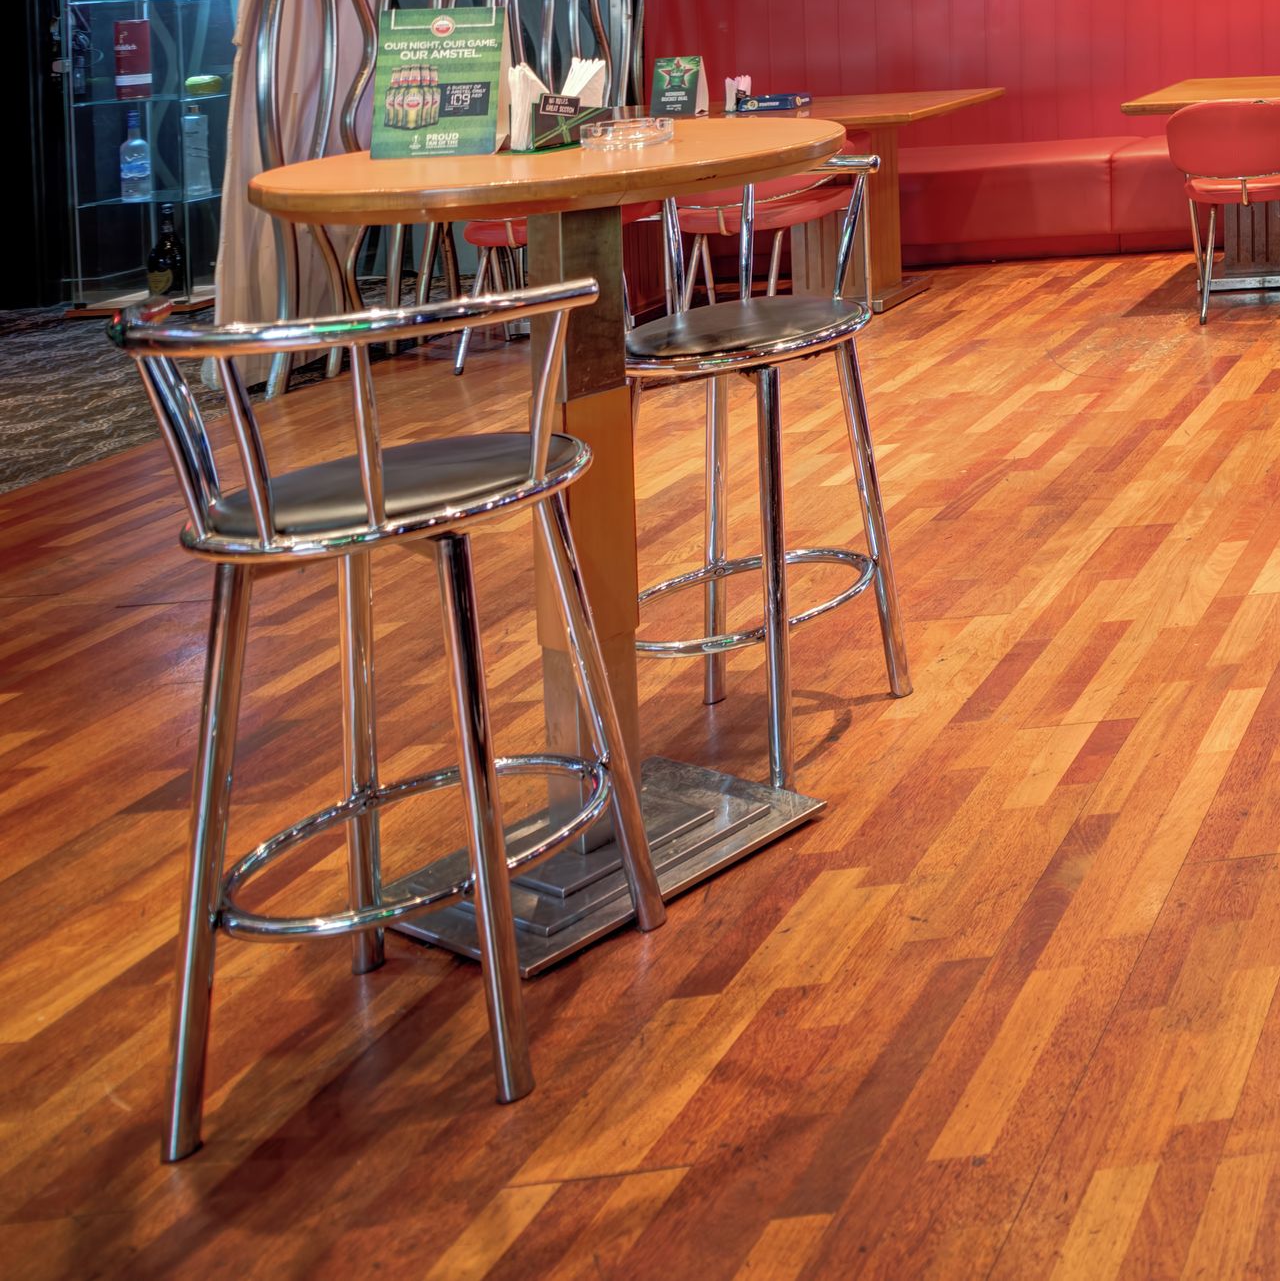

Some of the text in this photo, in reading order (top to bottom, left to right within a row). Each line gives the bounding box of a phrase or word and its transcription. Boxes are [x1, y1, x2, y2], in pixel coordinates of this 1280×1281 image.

[384, 38, 498, 51] OUR NIGHT, OUR GAME,
[400, 48, 482, 60] OUR AMSTEL.
[451, 94, 471, 106] 109
